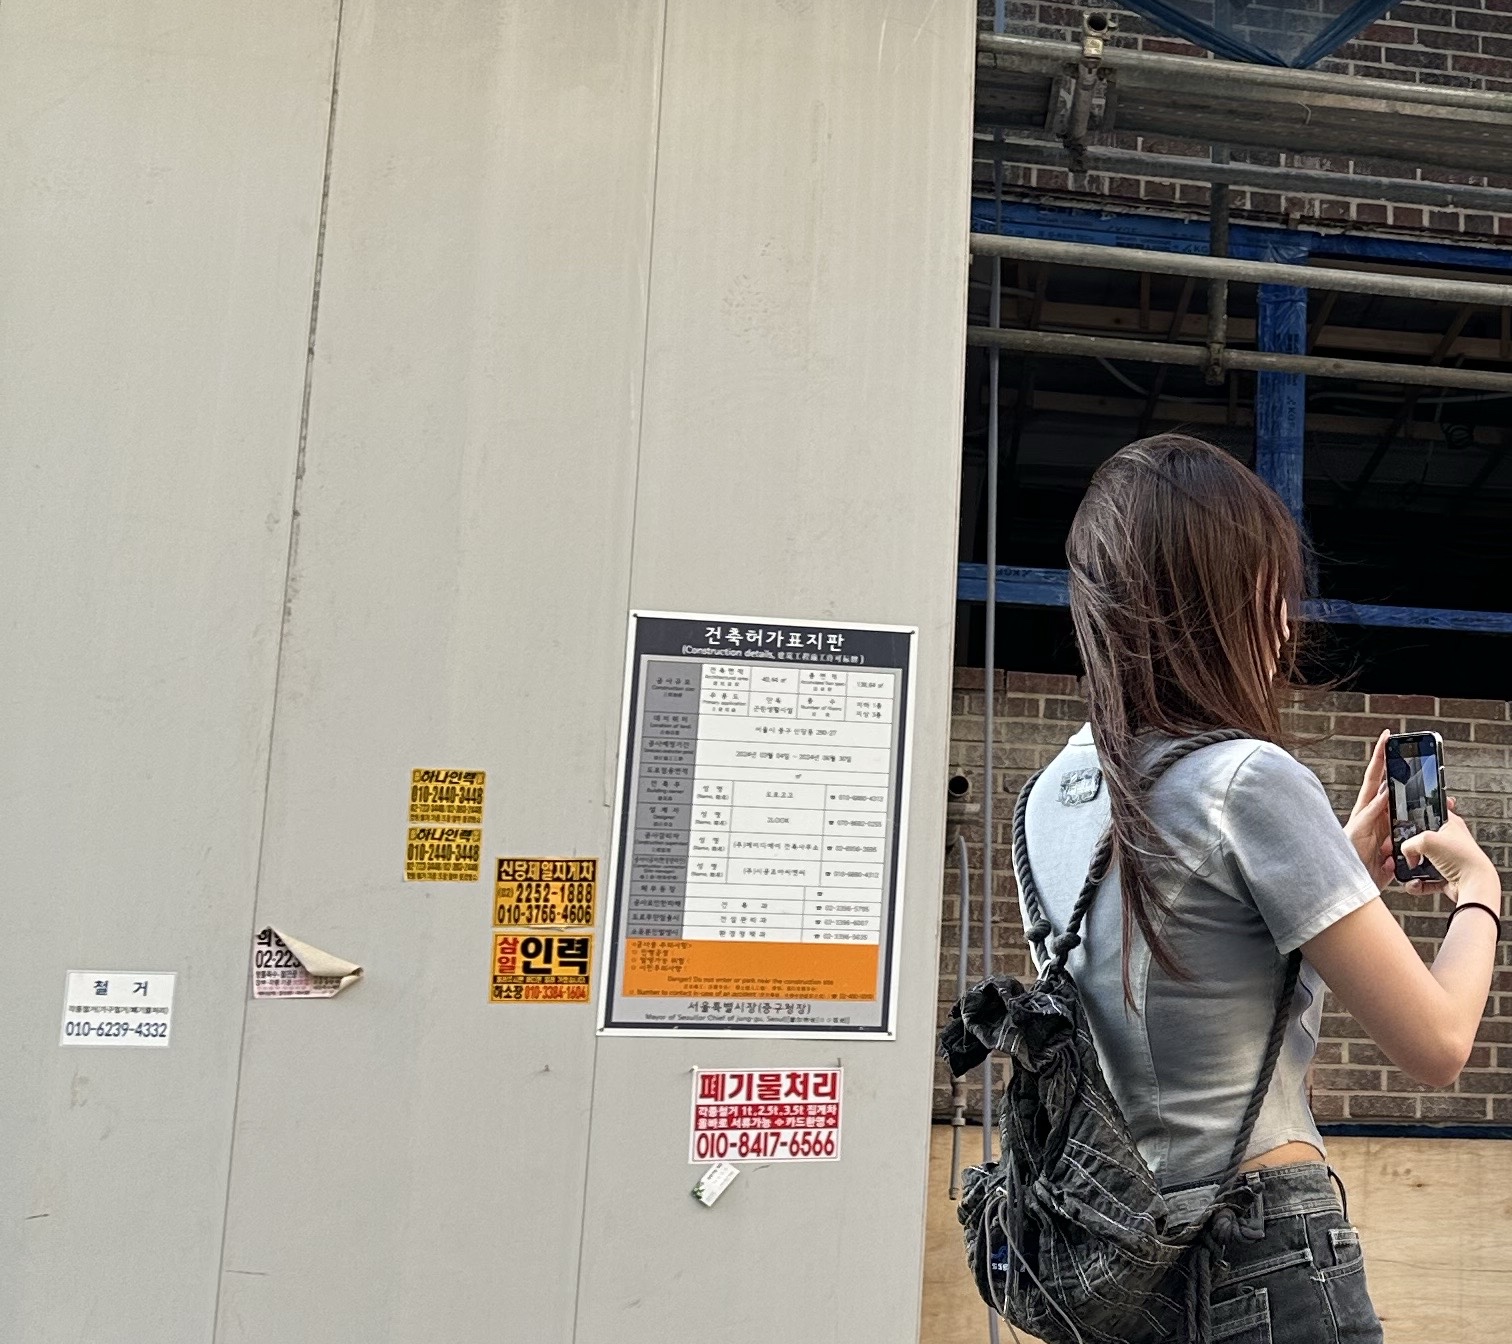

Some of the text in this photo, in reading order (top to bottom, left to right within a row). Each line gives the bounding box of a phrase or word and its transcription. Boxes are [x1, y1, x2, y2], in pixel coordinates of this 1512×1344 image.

[704, 625, 844, 651] 건축허가표지판
[421, 770, 476, 784] 하나인력
[416, 829, 473, 841] 하나인력
[516, 883, 593, 903] 2252-1888
[498, 904, 592, 924] 010-3766-4606
[498, 937, 589, 975] 삼일 인력
[65, 1021, 168, 1037] 010-6239-4332
[699, 1072, 837, 1101] 폐기물처리
[731, 1117, 772, 1129] 서류가능
[697, 1131, 835, 1158] 010-8417-6566
